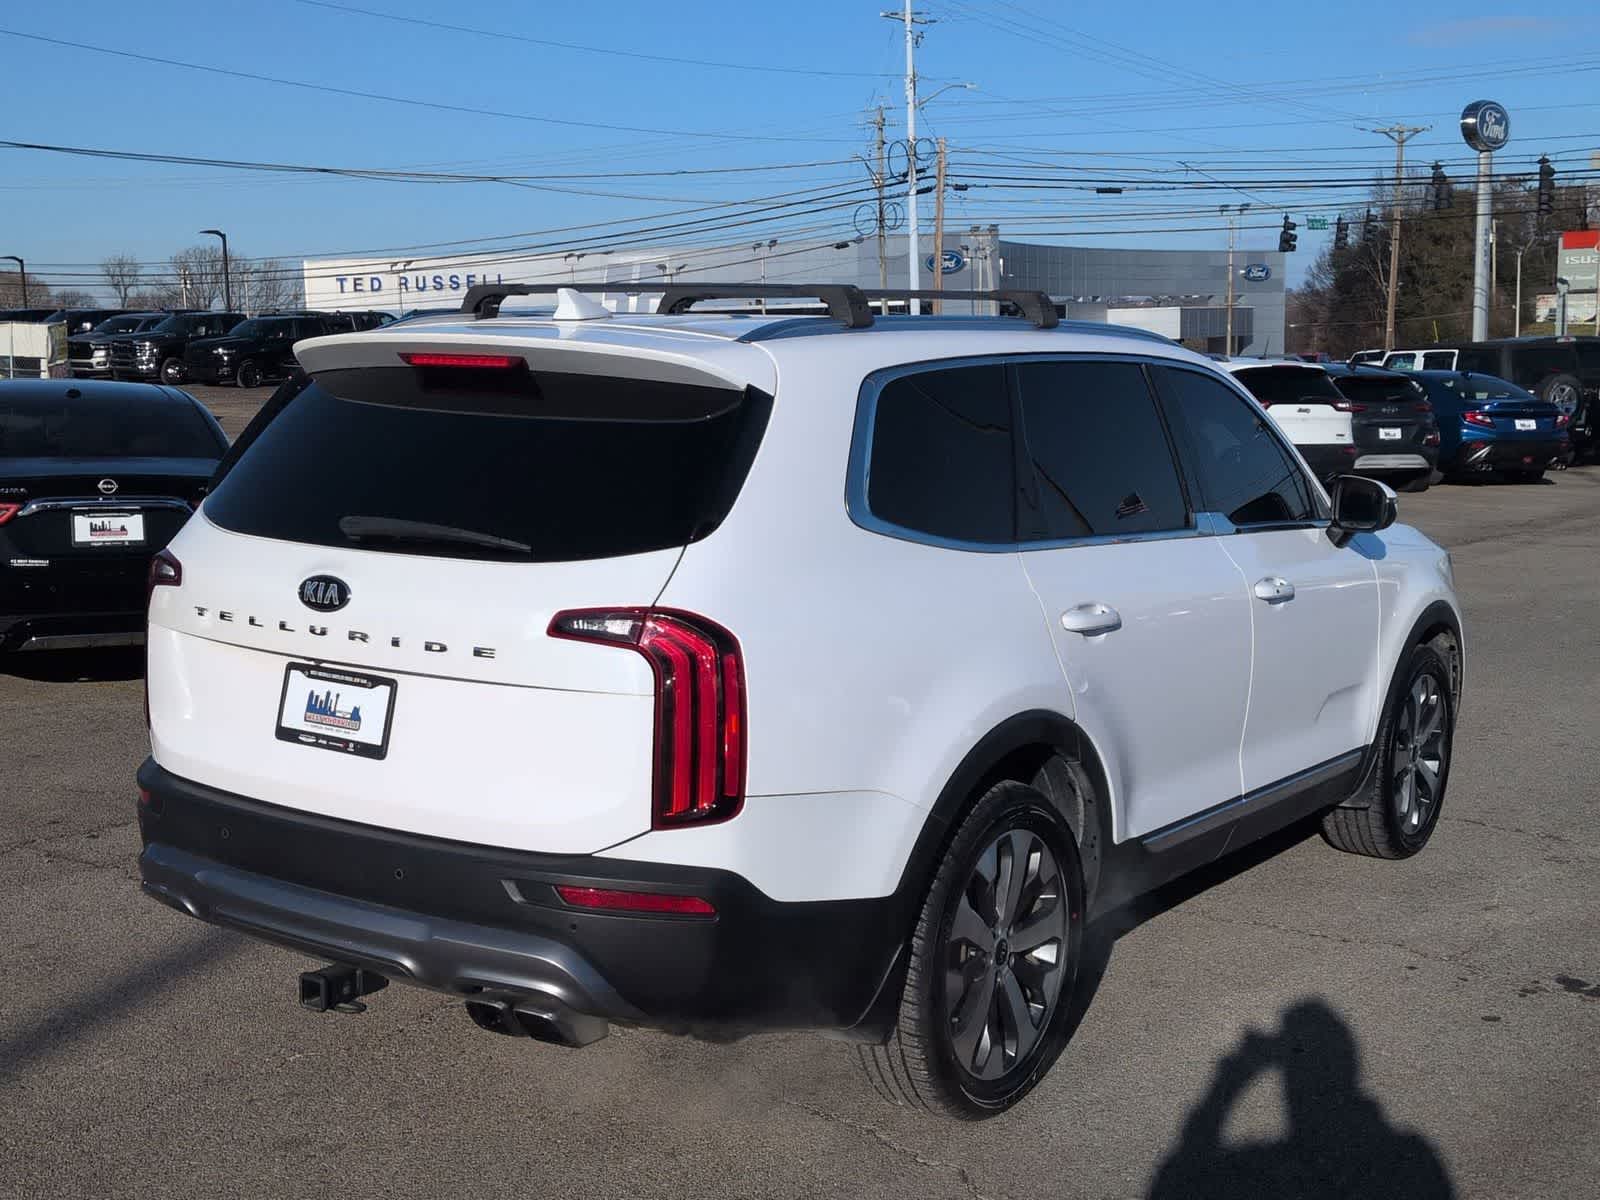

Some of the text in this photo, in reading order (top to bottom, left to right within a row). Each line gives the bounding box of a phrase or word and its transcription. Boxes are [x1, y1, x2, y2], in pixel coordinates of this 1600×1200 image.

[1483, 110, 1506, 140] Ford
[336, 277, 382, 293] TED
[303, 580, 340, 605] KIA
[193, 605, 497, 660] TELLURIDE
